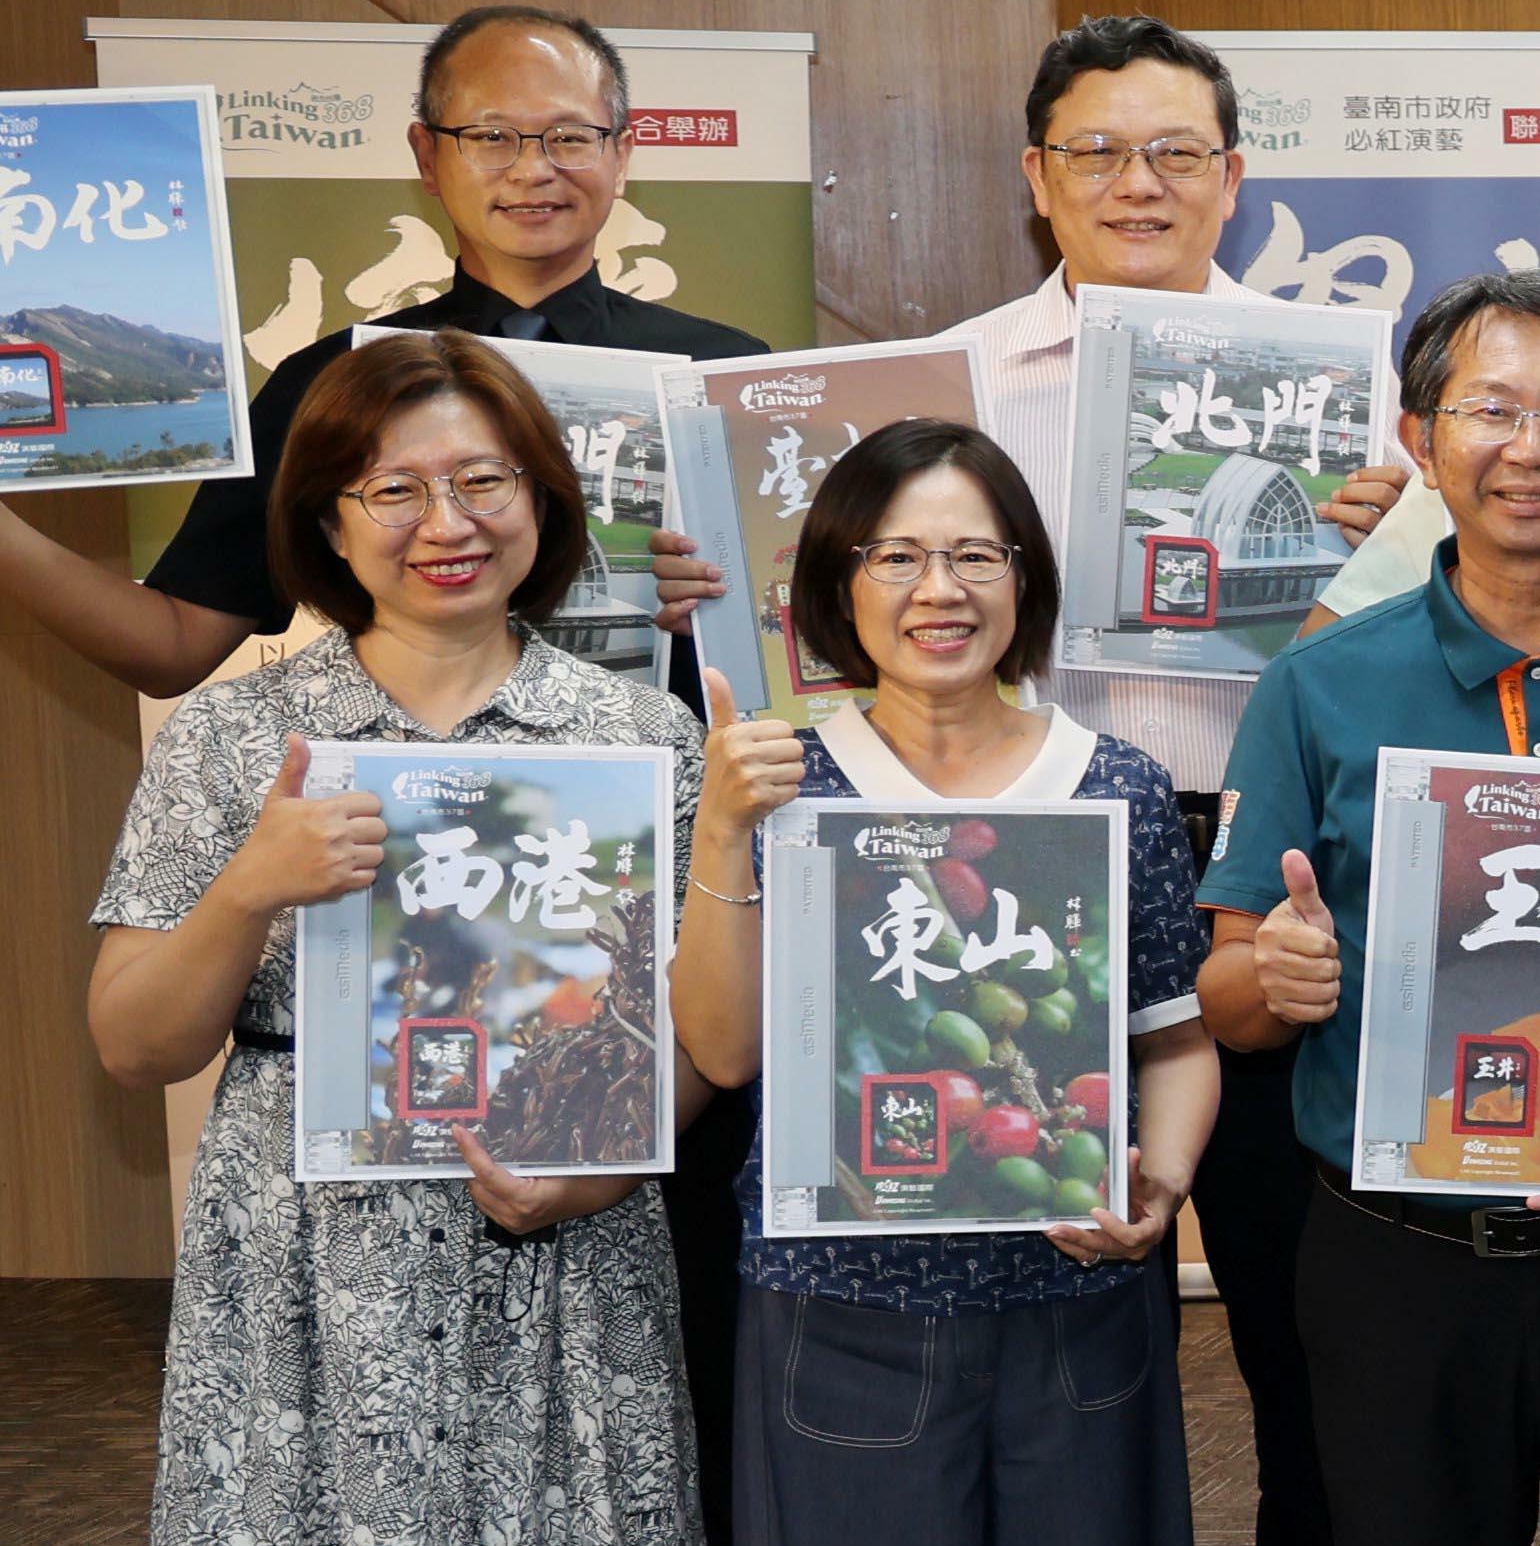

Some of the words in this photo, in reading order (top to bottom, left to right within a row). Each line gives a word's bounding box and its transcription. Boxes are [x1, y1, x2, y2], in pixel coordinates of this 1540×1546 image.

[228, 90, 320, 122] Linking
[322, 94, 374, 124] 368
[1343, 94, 1492, 120] 臺南市政府
[224, 114, 366, 150] Taiwan
[1344, 128, 1464, 152] 必紅演藝
[1166, 328, 1230, 350] Taiwan
[754, 380, 800, 393] Linking
[753, 391, 824, 407] Taiwan
[1152, 368, 1332, 477] 北門
[411, 767, 461, 788] Linking
[407, 781, 487, 804] Taiwan
[1482, 783, 1530, 804] Linking
[871, 825, 921, 844] Linking
[868, 838, 944, 859] Taiwan
[397, 819, 612, 929] 西港
[861, 878, 1054, 1001] 東山
